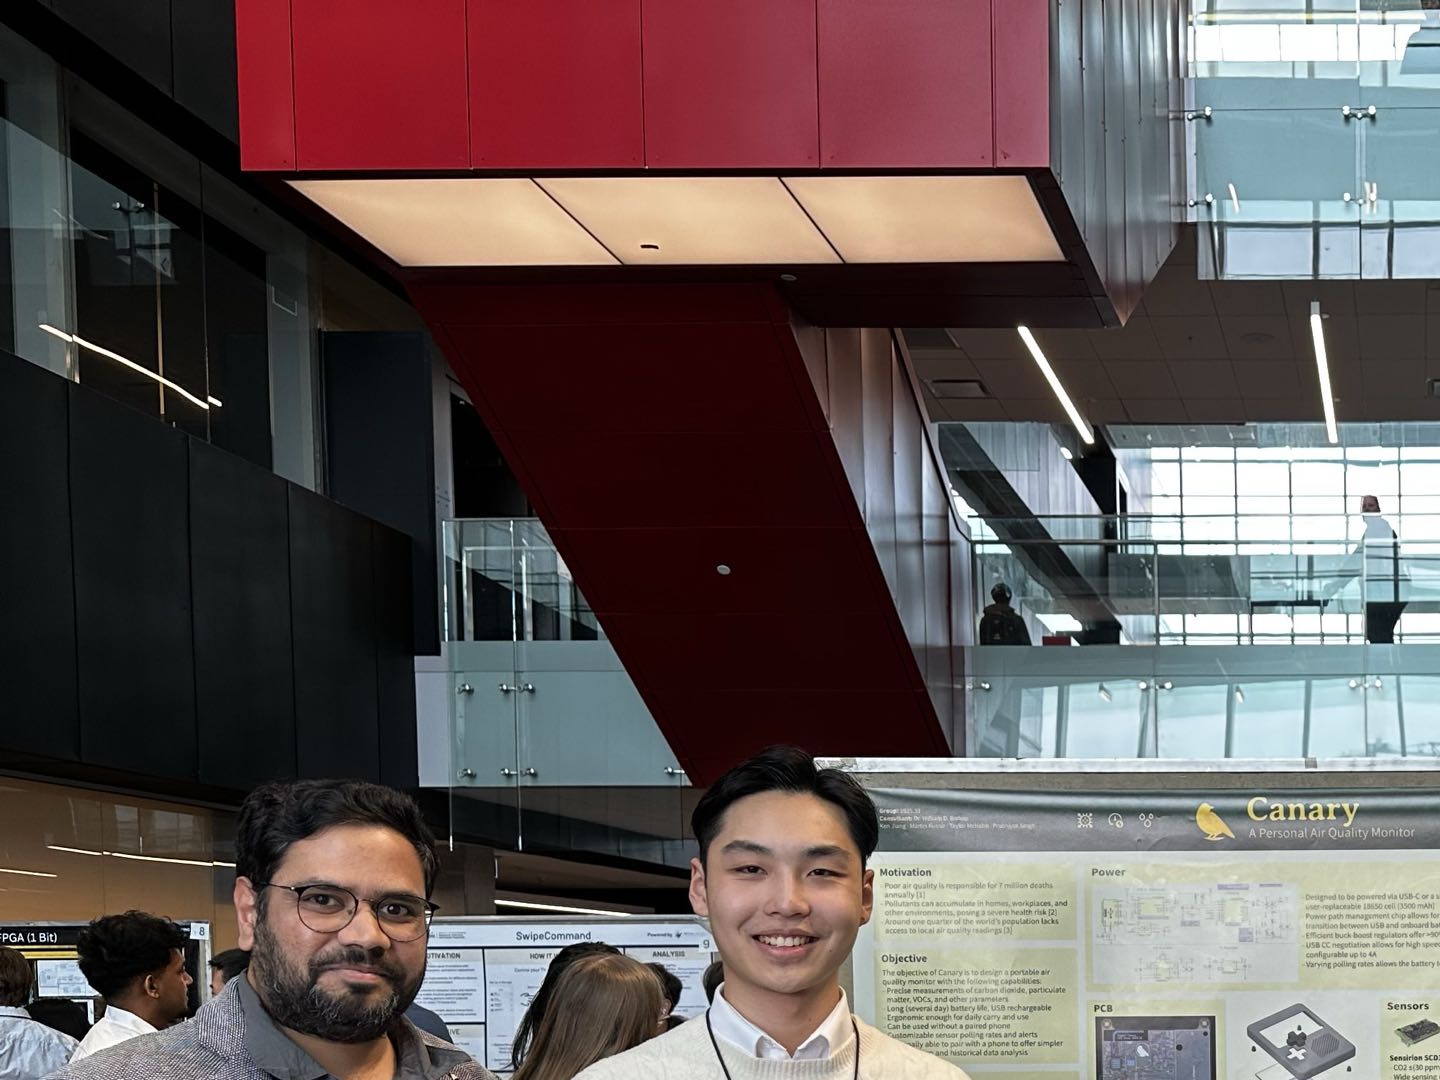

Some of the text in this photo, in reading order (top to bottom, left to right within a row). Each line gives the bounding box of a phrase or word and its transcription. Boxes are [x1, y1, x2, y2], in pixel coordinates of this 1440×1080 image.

[1247, 797, 1359, 827] Canary
[1250, 827, 1415, 840] A Personal Air Quality Monitor
[1092, 868, 1125, 876] Power
[199, 927, 205, 936] 8
[27, 932, 36, 943] (1
[39, 932, 57, 943] Bit)
[516, 932, 591, 941] SwipeCommand
[703, 940, 709, 949] 9
[881, 954, 927, 964] Objective
[1387, 1002, 1429, 1010] Sensors
[965, 1022, 987, 1031] paired
[989, 1022, 1010, 1031] phone
